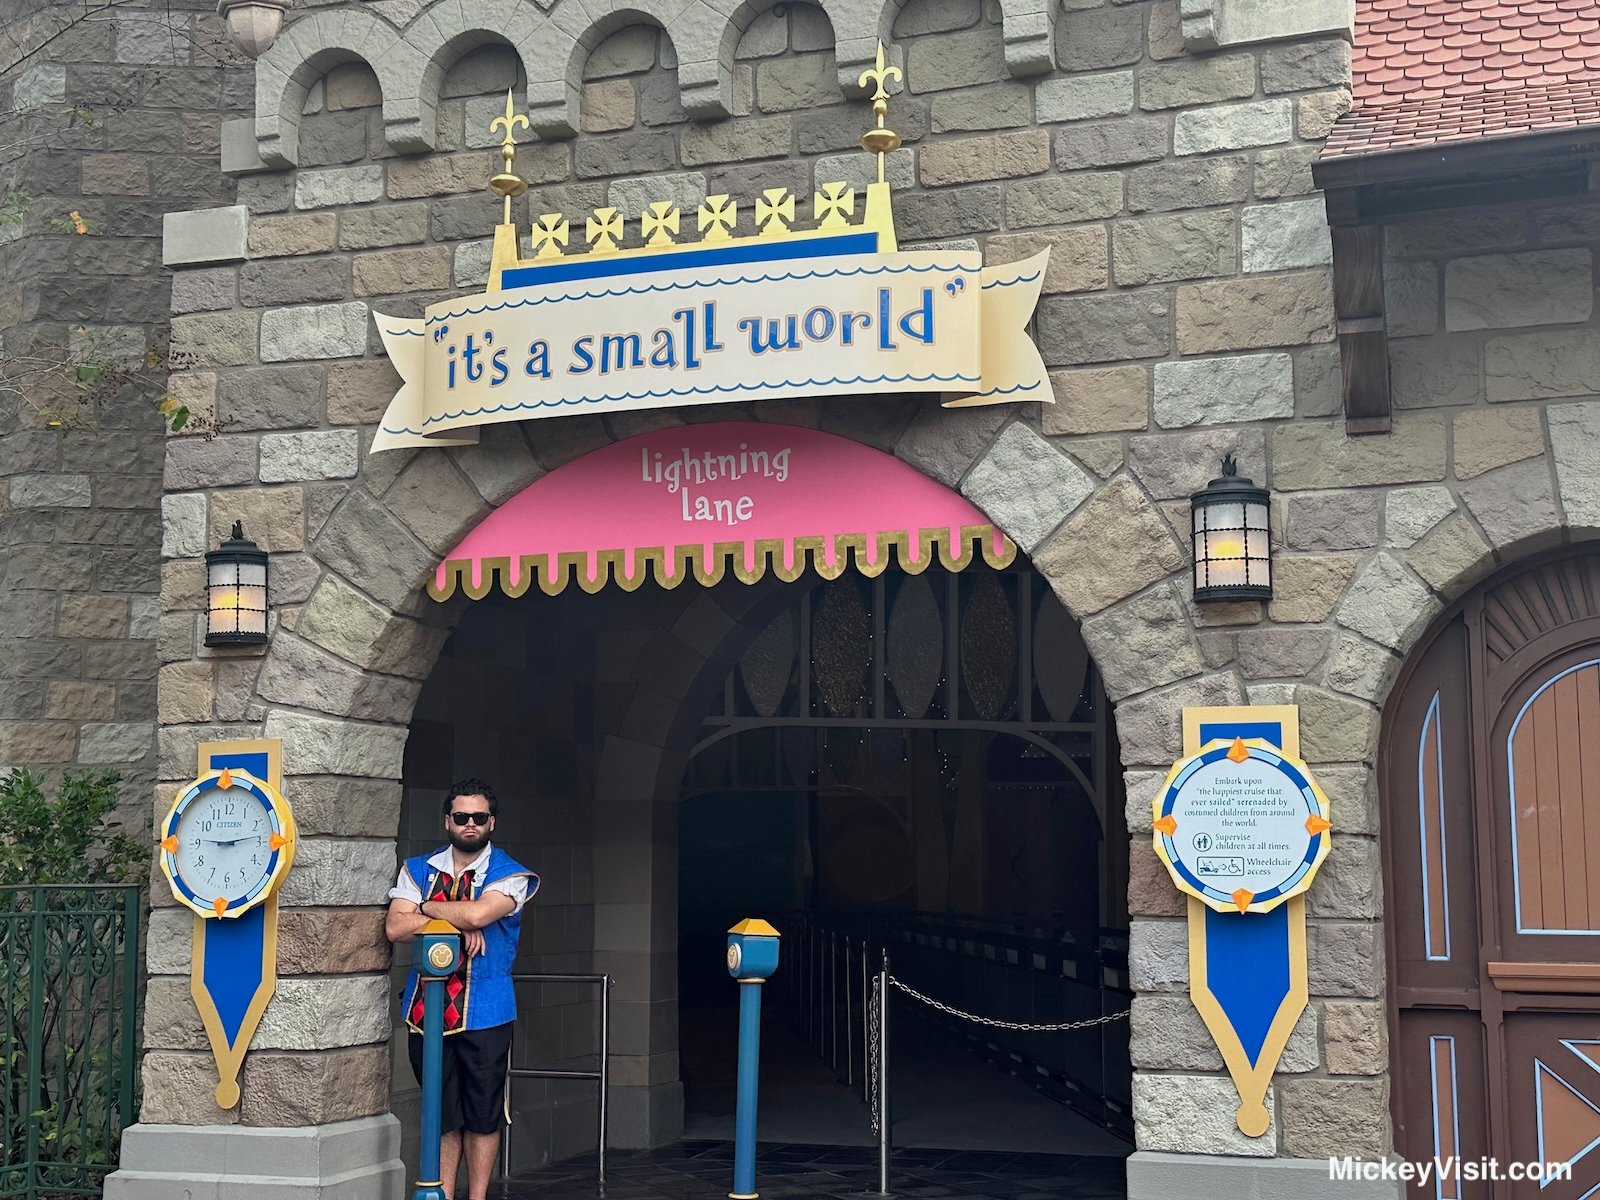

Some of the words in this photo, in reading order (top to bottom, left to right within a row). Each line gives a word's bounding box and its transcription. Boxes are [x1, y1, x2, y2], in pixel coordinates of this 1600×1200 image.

[524, 338, 553, 381] a
[567, 300, 725, 376] small
[641, 443, 791, 493] lightning
[682, 487, 754, 526] lane
[1215, 777, 1242, 785] Embark
[1244, 778, 1262, 787] upon
[1212, 787, 1243, 797] happiest
[1267, 787, 1282, 795] that
[1209, 798, 1235, 806] sailed"
[1237, 798, 1276, 806] serenaded
[1278, 798, 1288, 808] by
[212, 809, 220, 820] 11
[225, 803, 235, 815] 12
[243, 807, 247, 819] 1
[1184, 808, 1218, 816] costumed
[1220, 808, 1249, 816] children
[1250, 808, 1267, 816] from
[1269, 808, 1295, 816] around
[201, 820, 212, 832] 10
[252, 820, 258, 831] 2
[1221, 819, 1234, 827] the
[1235, 819, 1258, 827] world.
[256, 835, 262, 847] 3
[1215, 833, 1251, 842] Supervise
[195, 838, 201, 850] 9
[1215, 842, 1246, 850] children
[1257, 842, 1267, 850] all
[1268, 842, 1291, 850] times.
[198, 855, 204, 866] 8
[251, 854, 257, 865] 4
[1247, 858, 1292, 866] Wheelchair
[210, 867, 216, 879] 7
[224, 872, 230, 883] 6
[240, 868, 245, 879] 5
